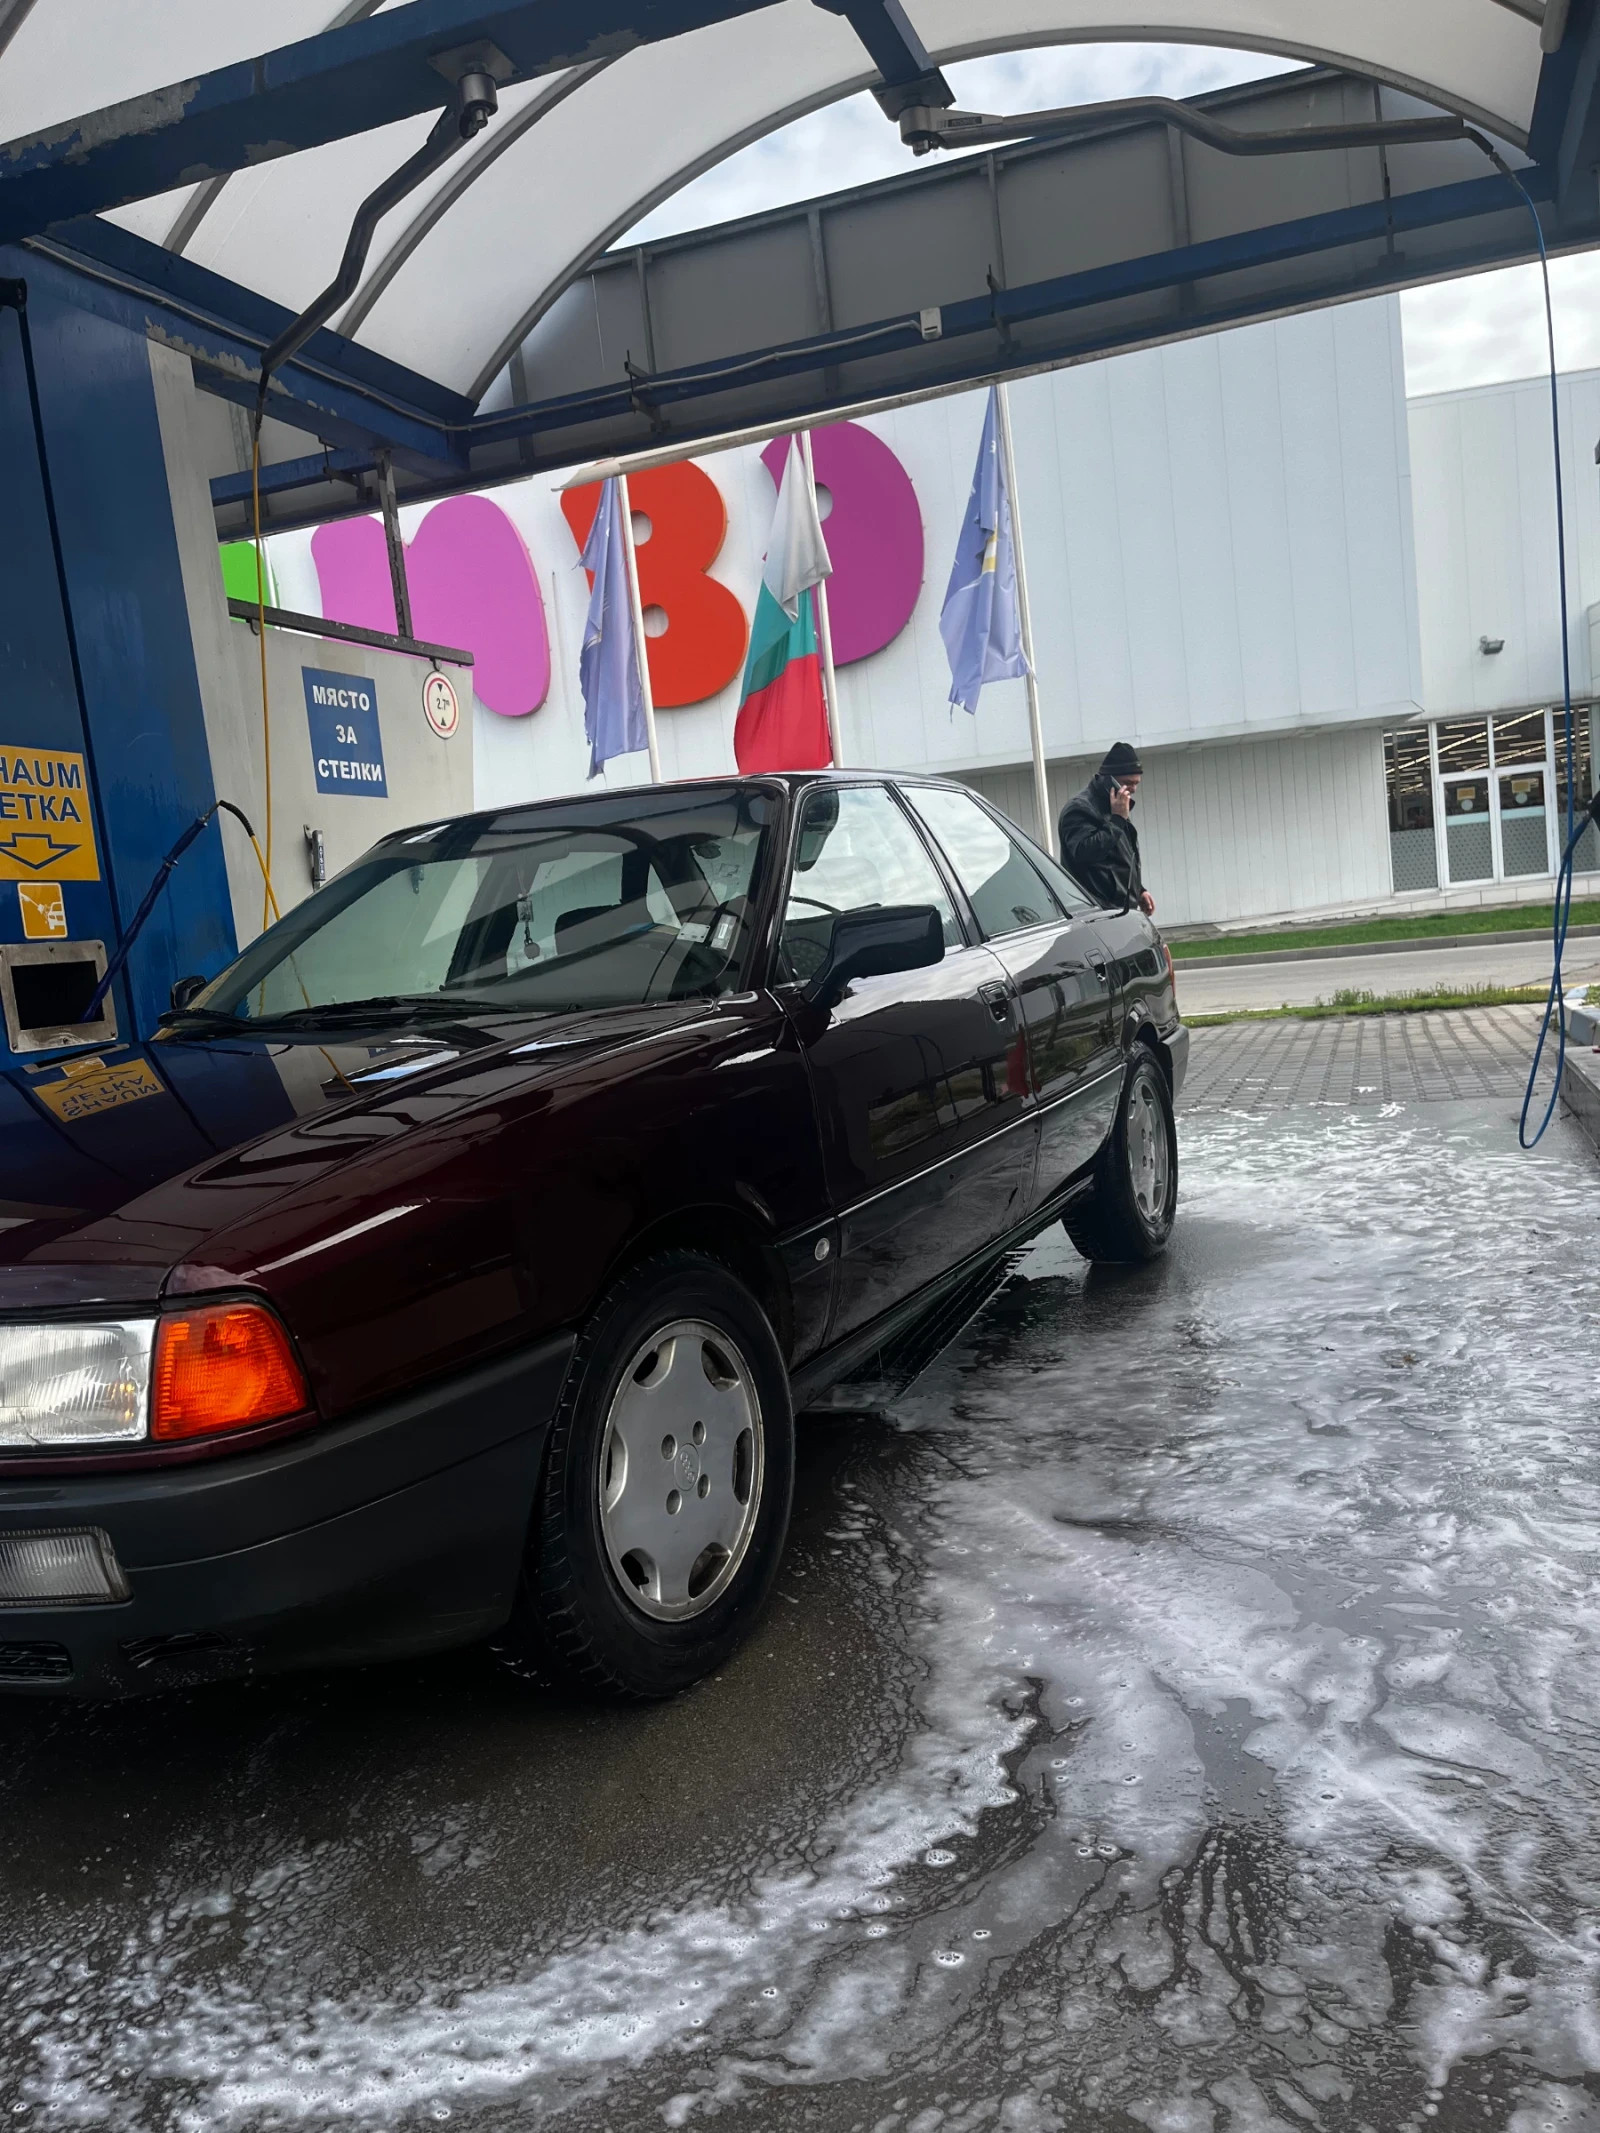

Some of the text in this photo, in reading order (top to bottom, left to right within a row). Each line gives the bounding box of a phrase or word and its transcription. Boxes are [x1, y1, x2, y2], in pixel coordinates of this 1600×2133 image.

[312, 685, 370, 711] МЯСТО
[336, 725, 358, 744] ЗА
[318, 759, 382, 781] СТЕЛКИ
